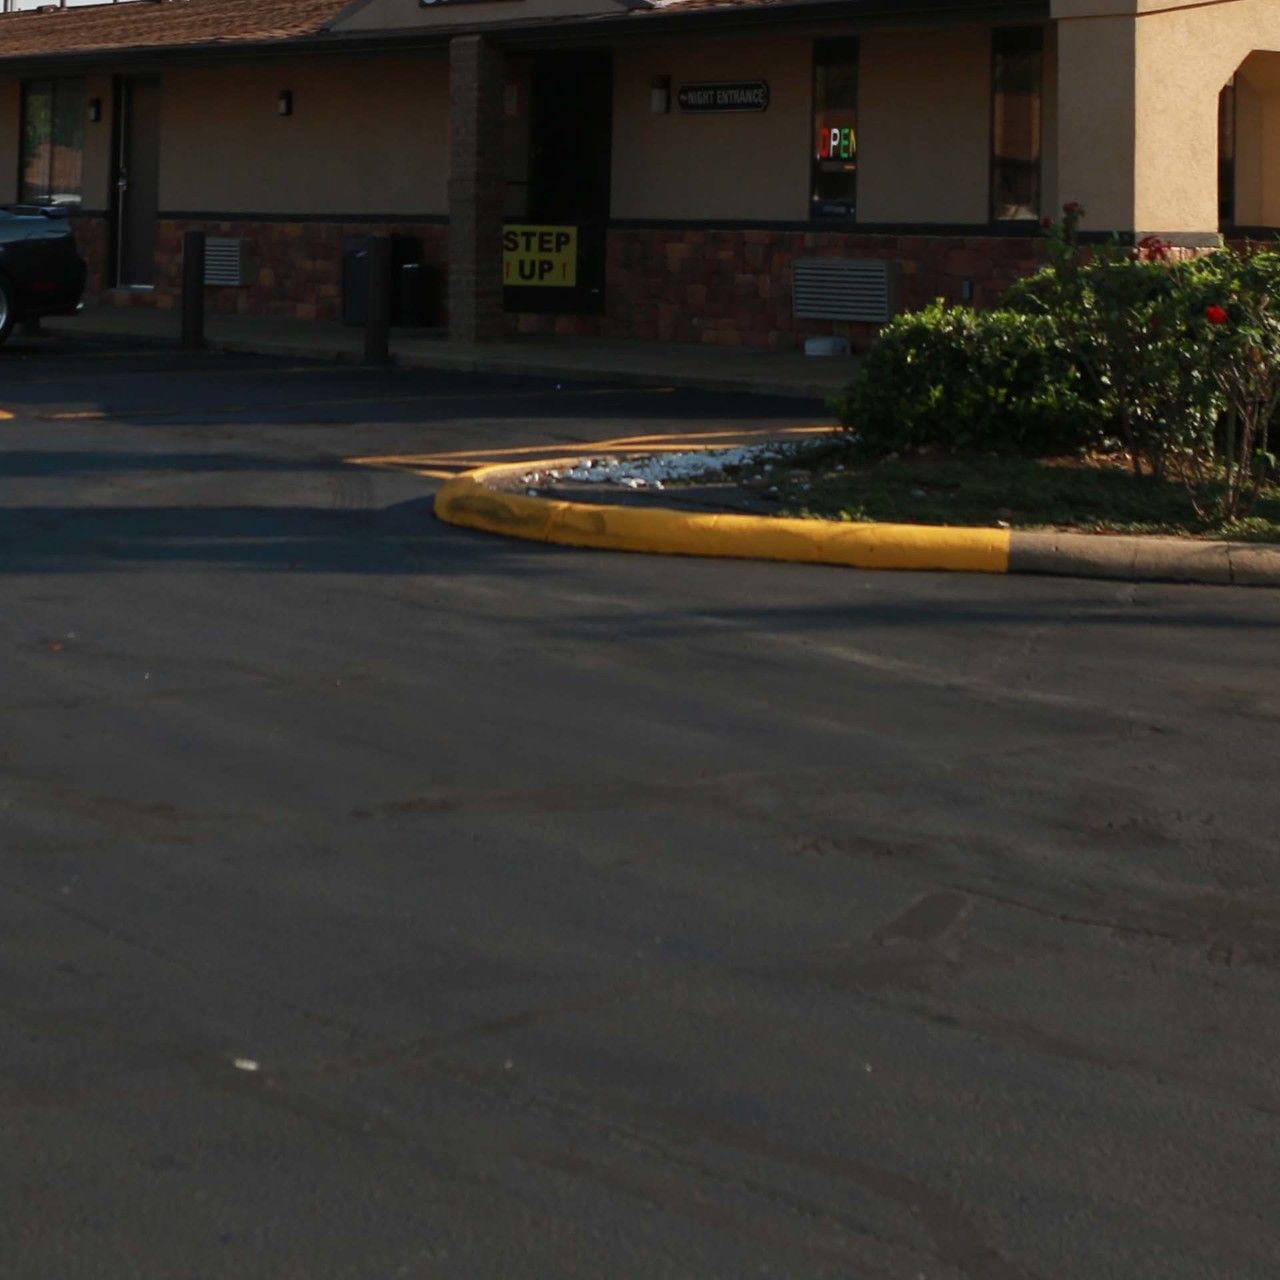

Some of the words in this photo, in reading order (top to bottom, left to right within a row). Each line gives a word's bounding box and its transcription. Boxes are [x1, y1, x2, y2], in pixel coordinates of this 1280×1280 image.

[687, 90, 715, 104] NIGHT
[716, 88, 765, 104] ENTRANCE
[504, 230, 570, 253] STEP
[519, 259, 553, 280] UP
